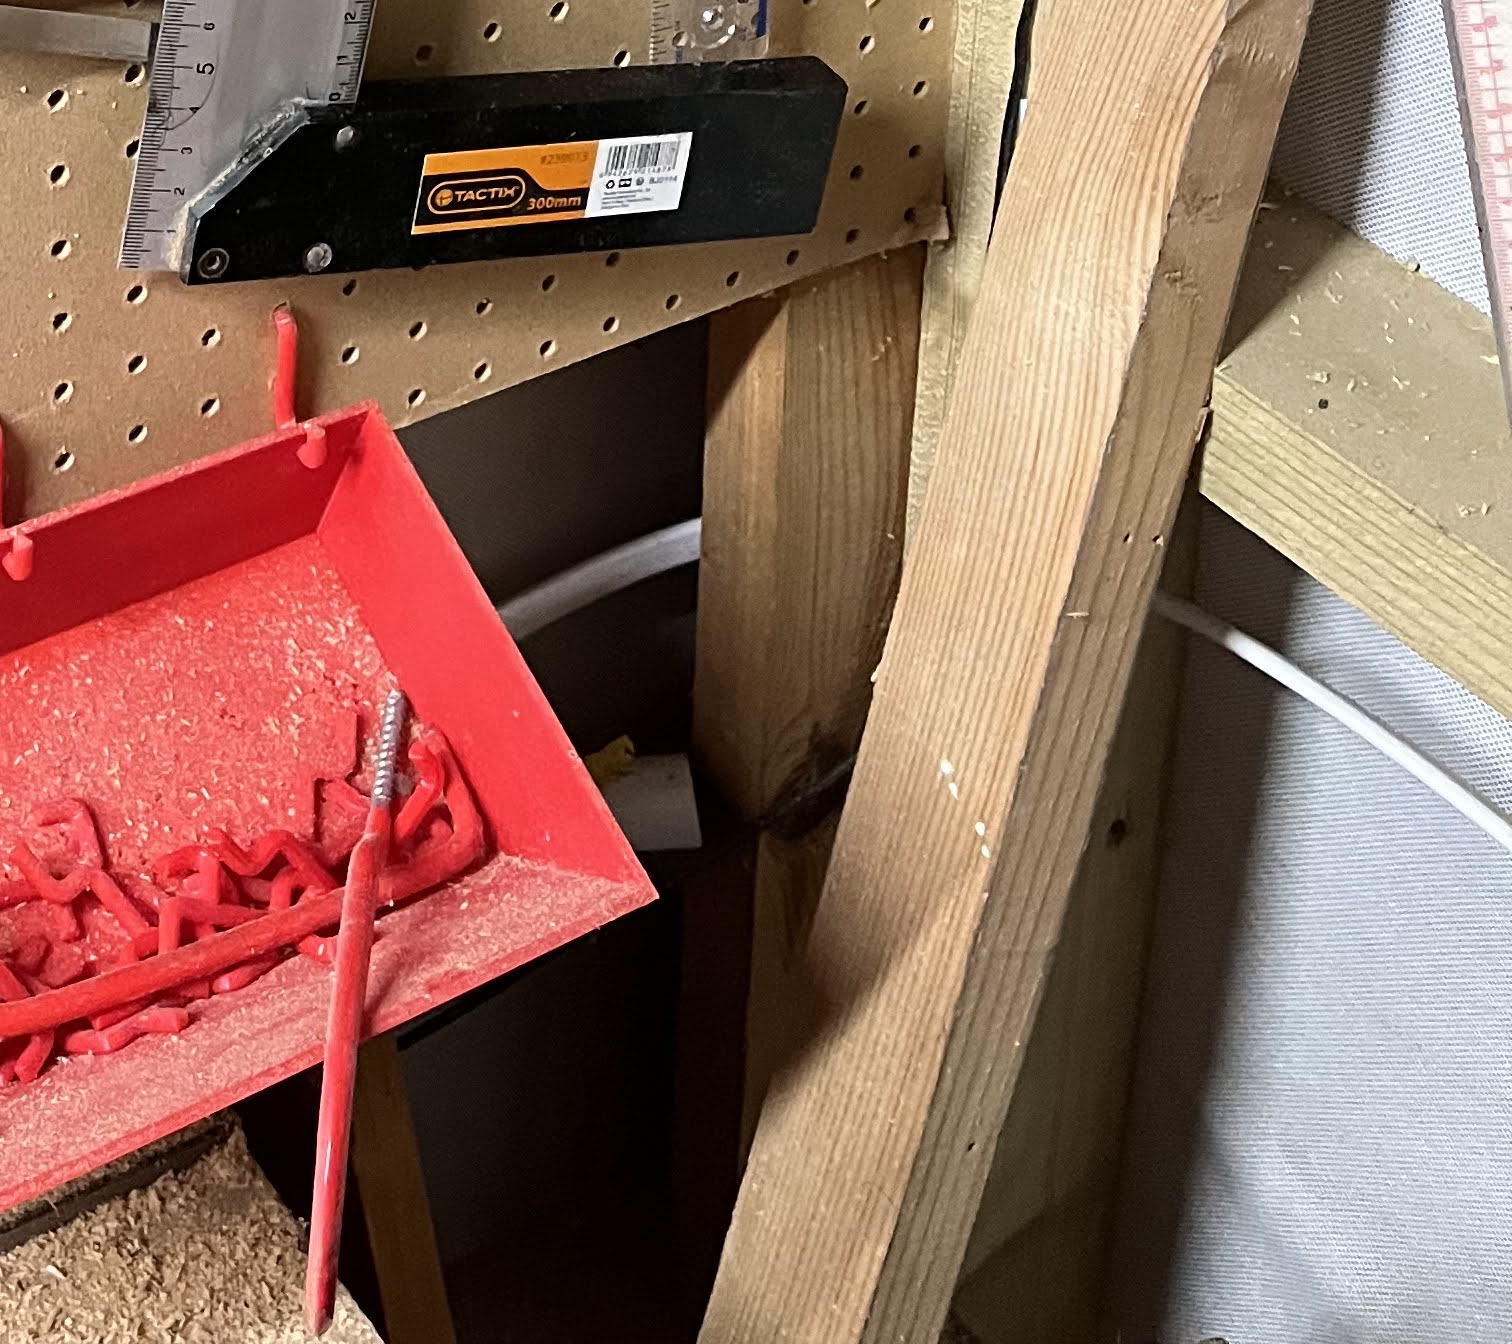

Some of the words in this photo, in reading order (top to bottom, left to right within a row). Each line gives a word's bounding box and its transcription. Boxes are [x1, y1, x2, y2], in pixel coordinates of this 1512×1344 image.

[203, 22, 215, 31] 6
[329, 92, 341, 102] 0
[344, 12, 356, 21] 2
[196, 62, 215, 75] 5
[180, 146, 193, 155] 3
[173, 187, 186, 195] 2
[455, 185, 518, 203] TACTIX
[527, 195, 582, 211] 300mm
